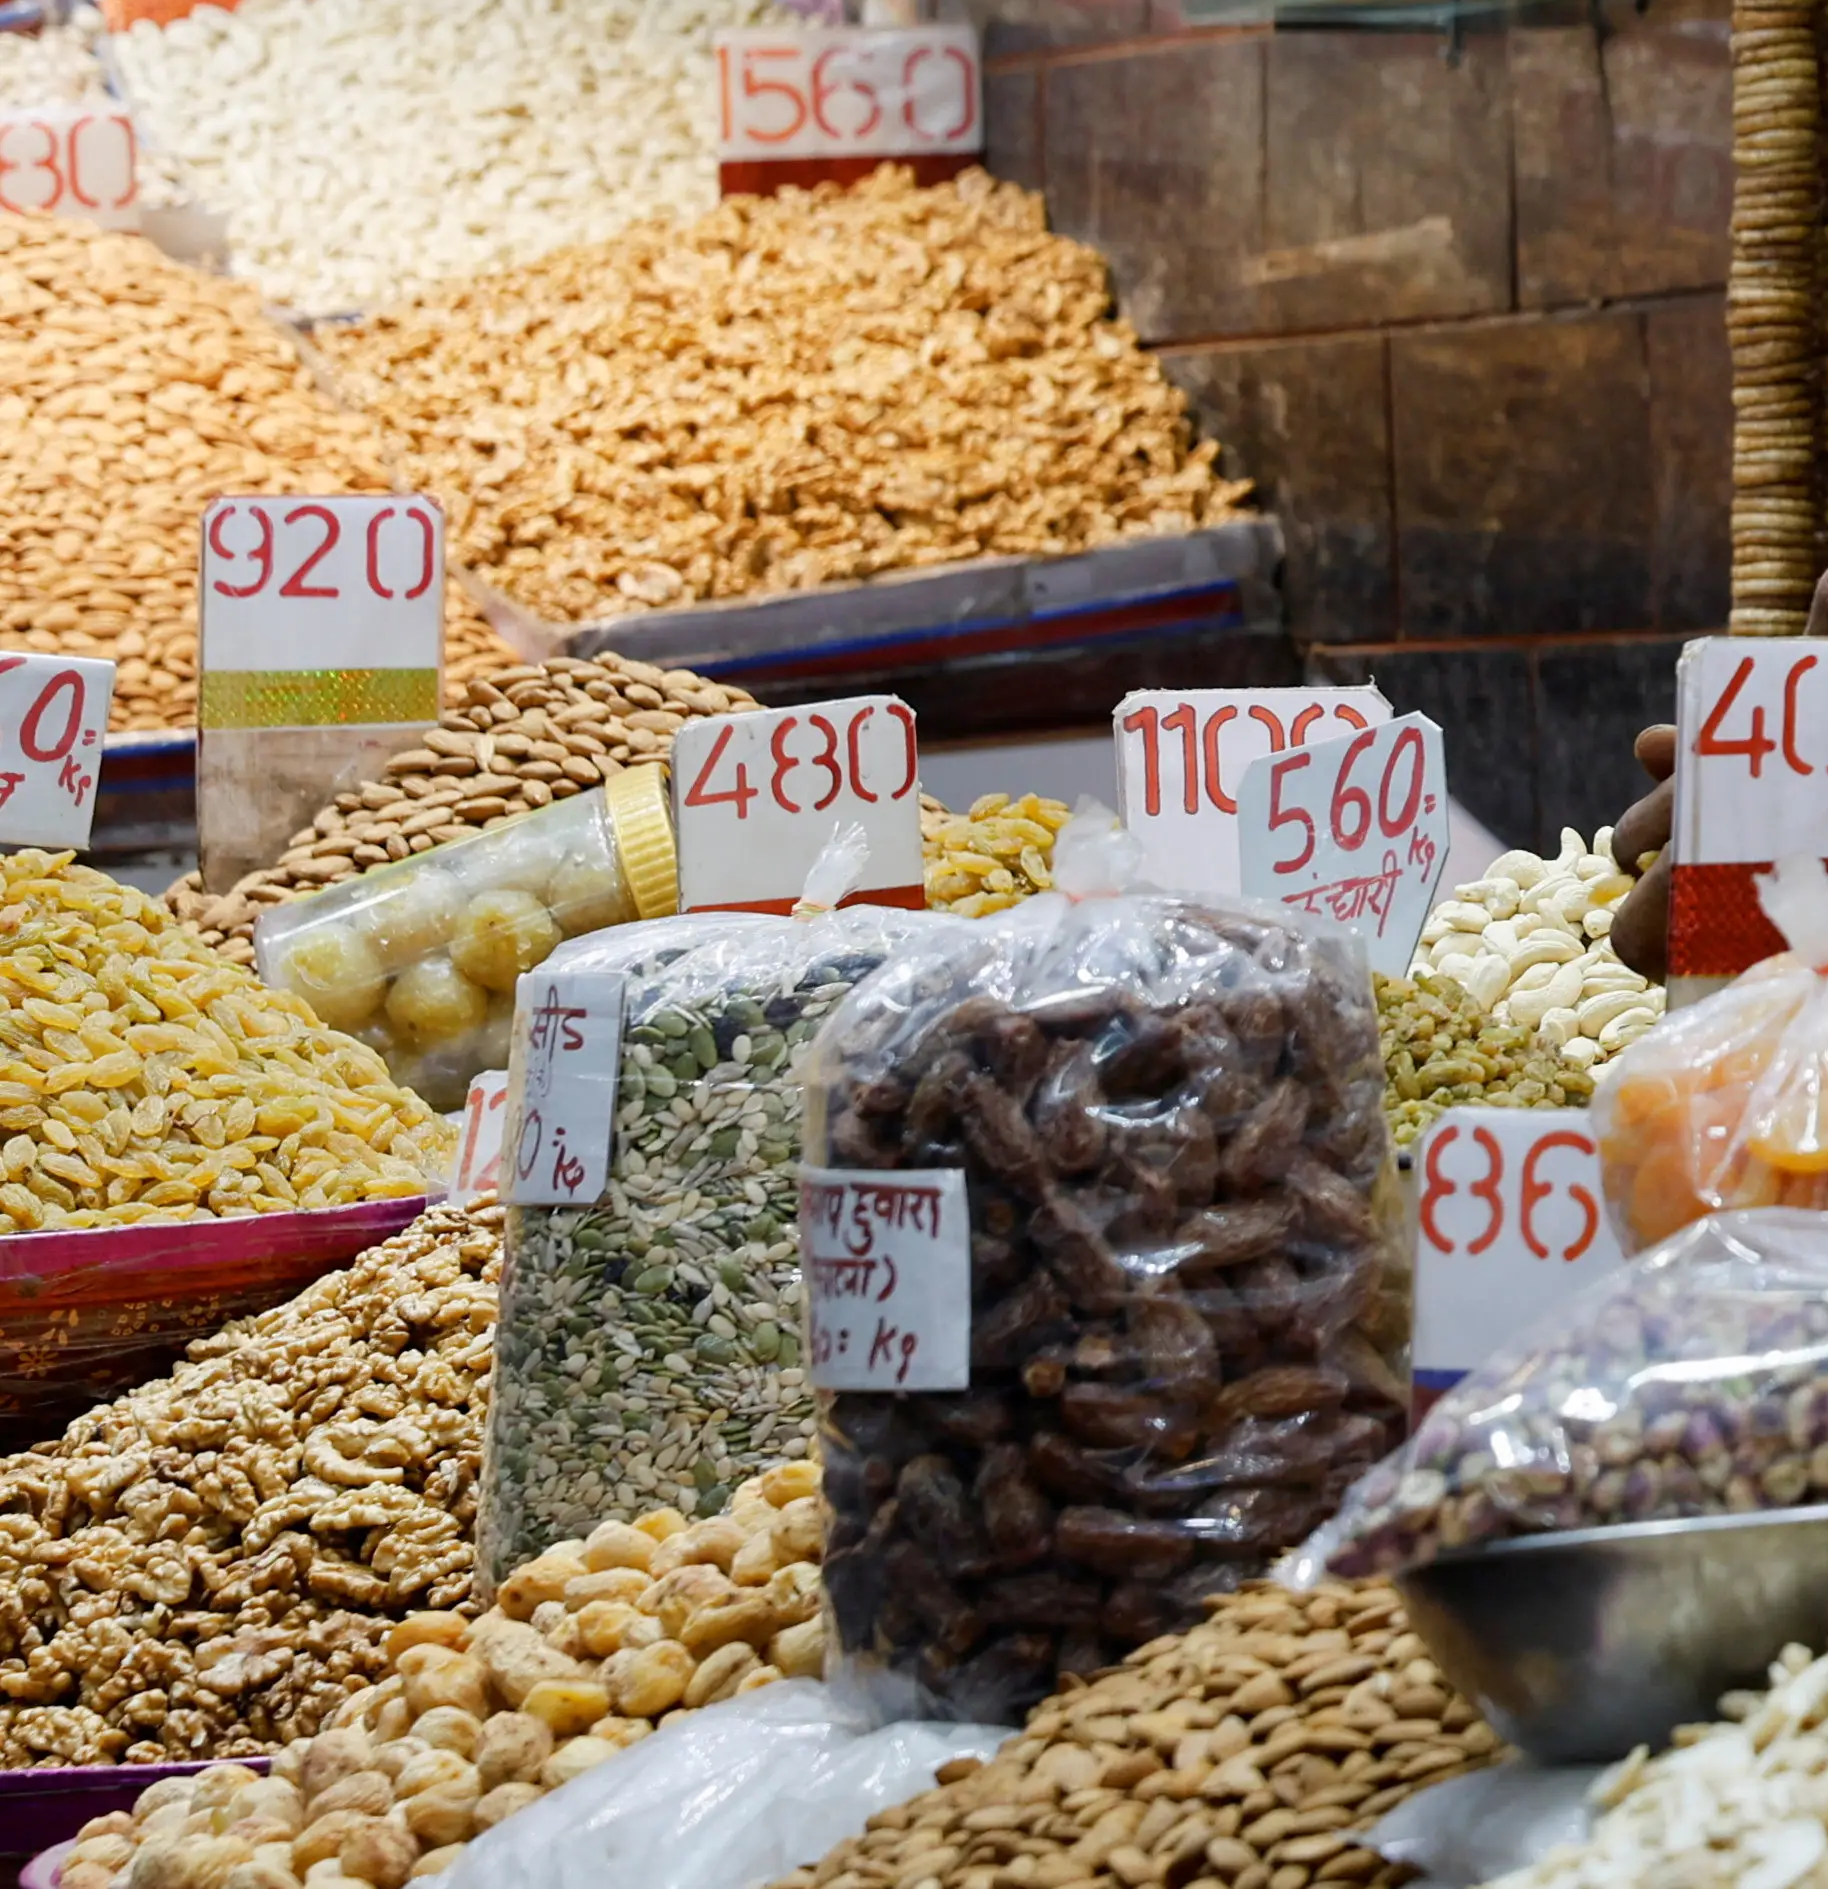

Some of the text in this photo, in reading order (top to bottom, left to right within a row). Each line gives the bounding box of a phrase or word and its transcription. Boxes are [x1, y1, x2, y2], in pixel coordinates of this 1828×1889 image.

[715, 44, 977, 143] 1560
[206, 503, 437, 601] 920
[683, 703, 918, 820] 480
